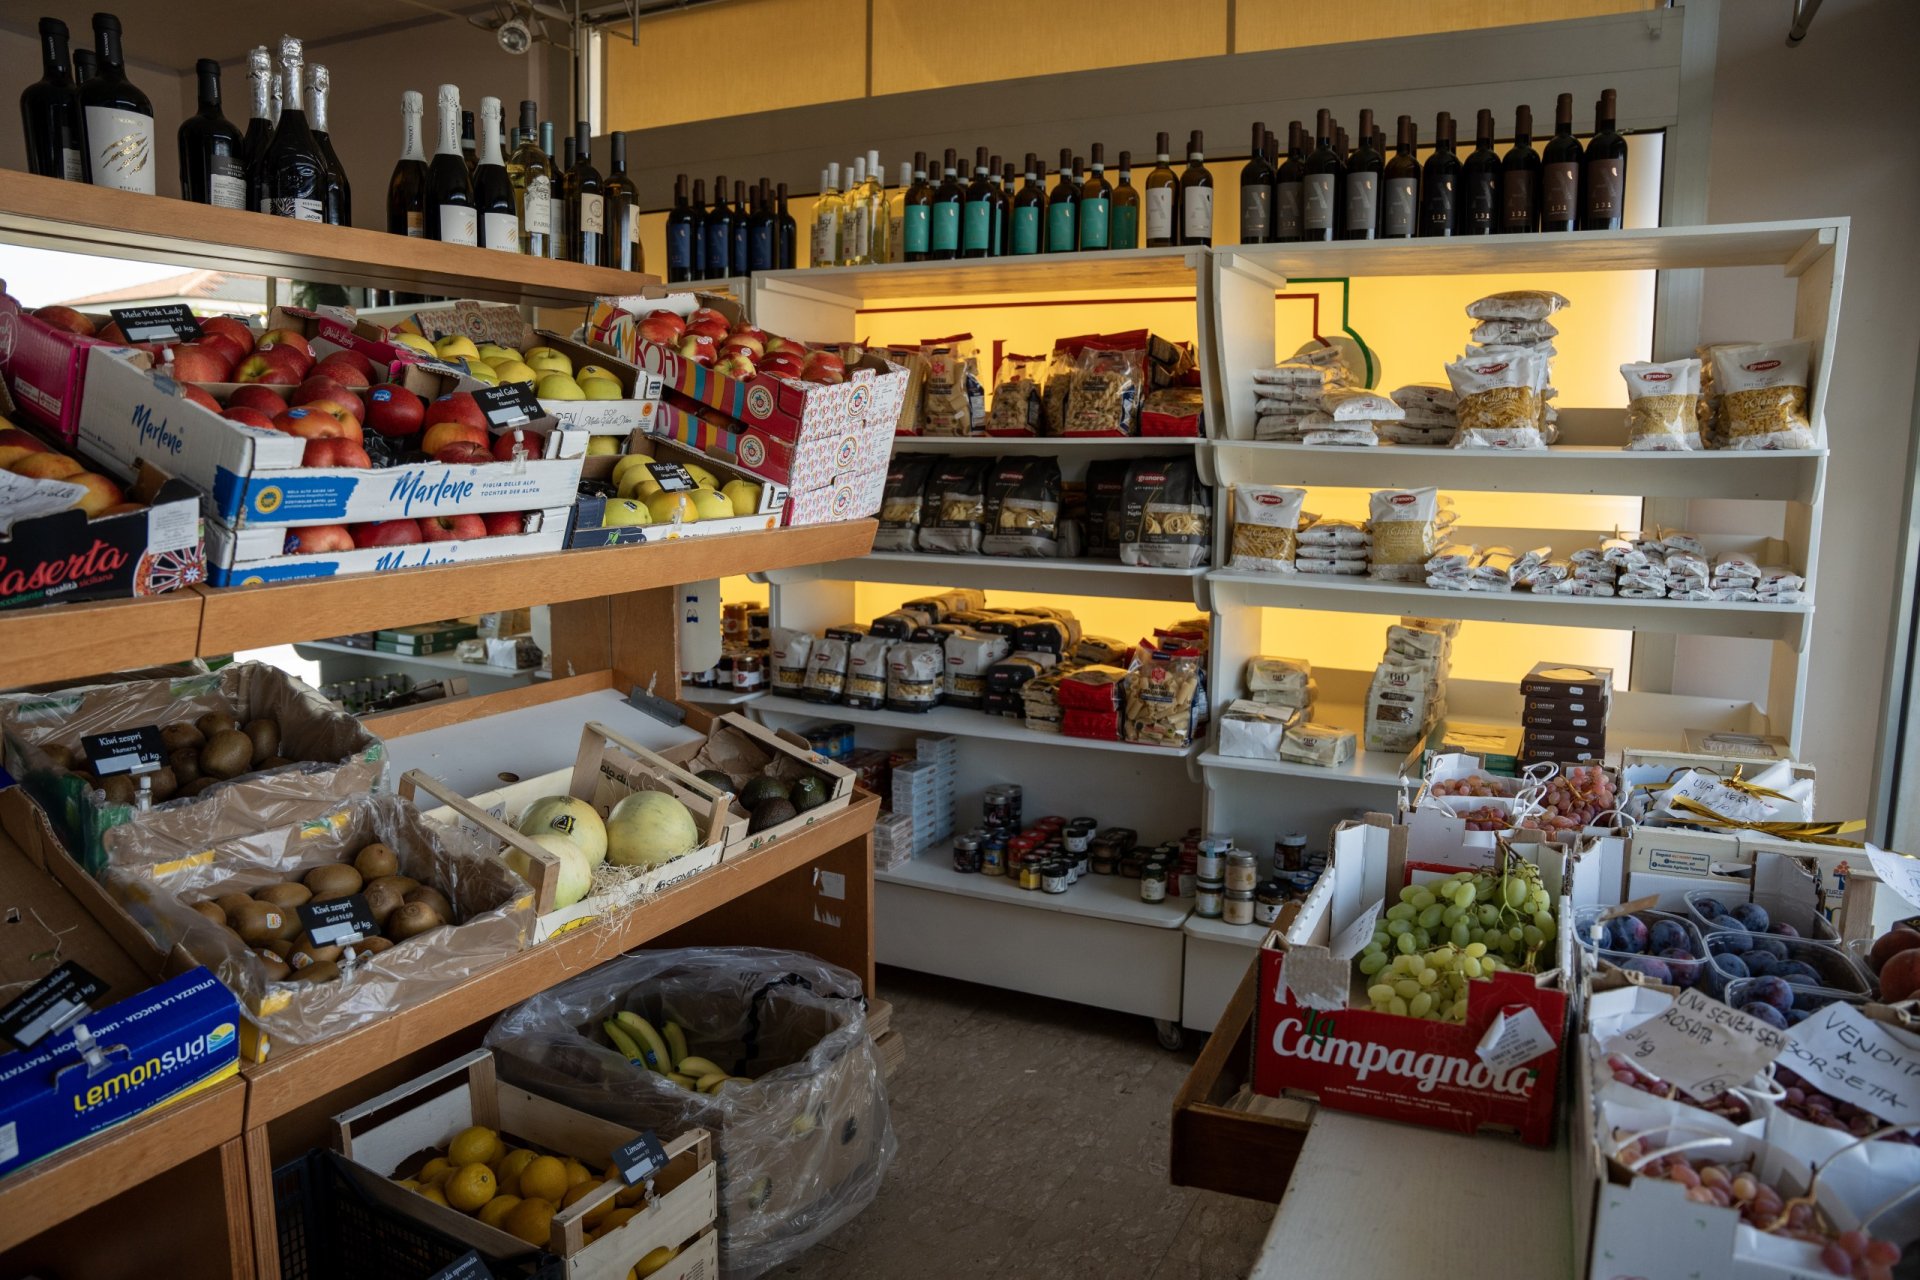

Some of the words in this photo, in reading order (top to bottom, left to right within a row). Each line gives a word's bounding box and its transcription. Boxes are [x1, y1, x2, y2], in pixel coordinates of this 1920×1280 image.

[120, 311, 142, 319] Mele
[141, 307, 163, 317] Pink
[162, 306, 183, 316] Lady
[183, 324, 196, 333] kg.
[1749, 361, 1781, 370] granoro
[1644, 372, 1671, 381] granoro
[486, 388, 505, 400] Royal
[503, 386, 519, 397] Gala
[132, 404, 182, 456] Marlene
[1137, 474, 1166, 482] granoro
[389, 469, 474, 516] Marlene
[1392, 495, 1415, 503] granoro
[0, 538, 128, 596] aserta
[45, 581, 78, 597] qualità
[98, 736, 117, 746] Kiwi
[118, 731, 143, 743] zespri
[141, 753, 148, 761] al
[149, 752, 162, 760] kg.
[1693, 778, 1714, 792] UVA
[312, 904, 331, 915] Kiwi
[330, 900, 353, 912] zespri
[353, 921, 360, 930] al
[361, 920, 373, 929] kg.
[73, 991, 83, 1003] al
[81, 983, 97, 995] kg
[175, 978, 216, 1001] UTILIZZA
[162, 996, 176, 1009] LA
[125, 1003, 163, 1023] BUCCIA
[1678, 992, 1704, 1013] UVA
[1706, 1007, 1753, 1034] SENZA
[1304, 1009, 1336, 1038] la
[1660, 1008, 1713, 1044] ROSATA
[1836, 1051, 1857, 1066] A
[73, 1035, 205, 1112] lemonsud
[624, 1138, 647, 1156] Limoni
